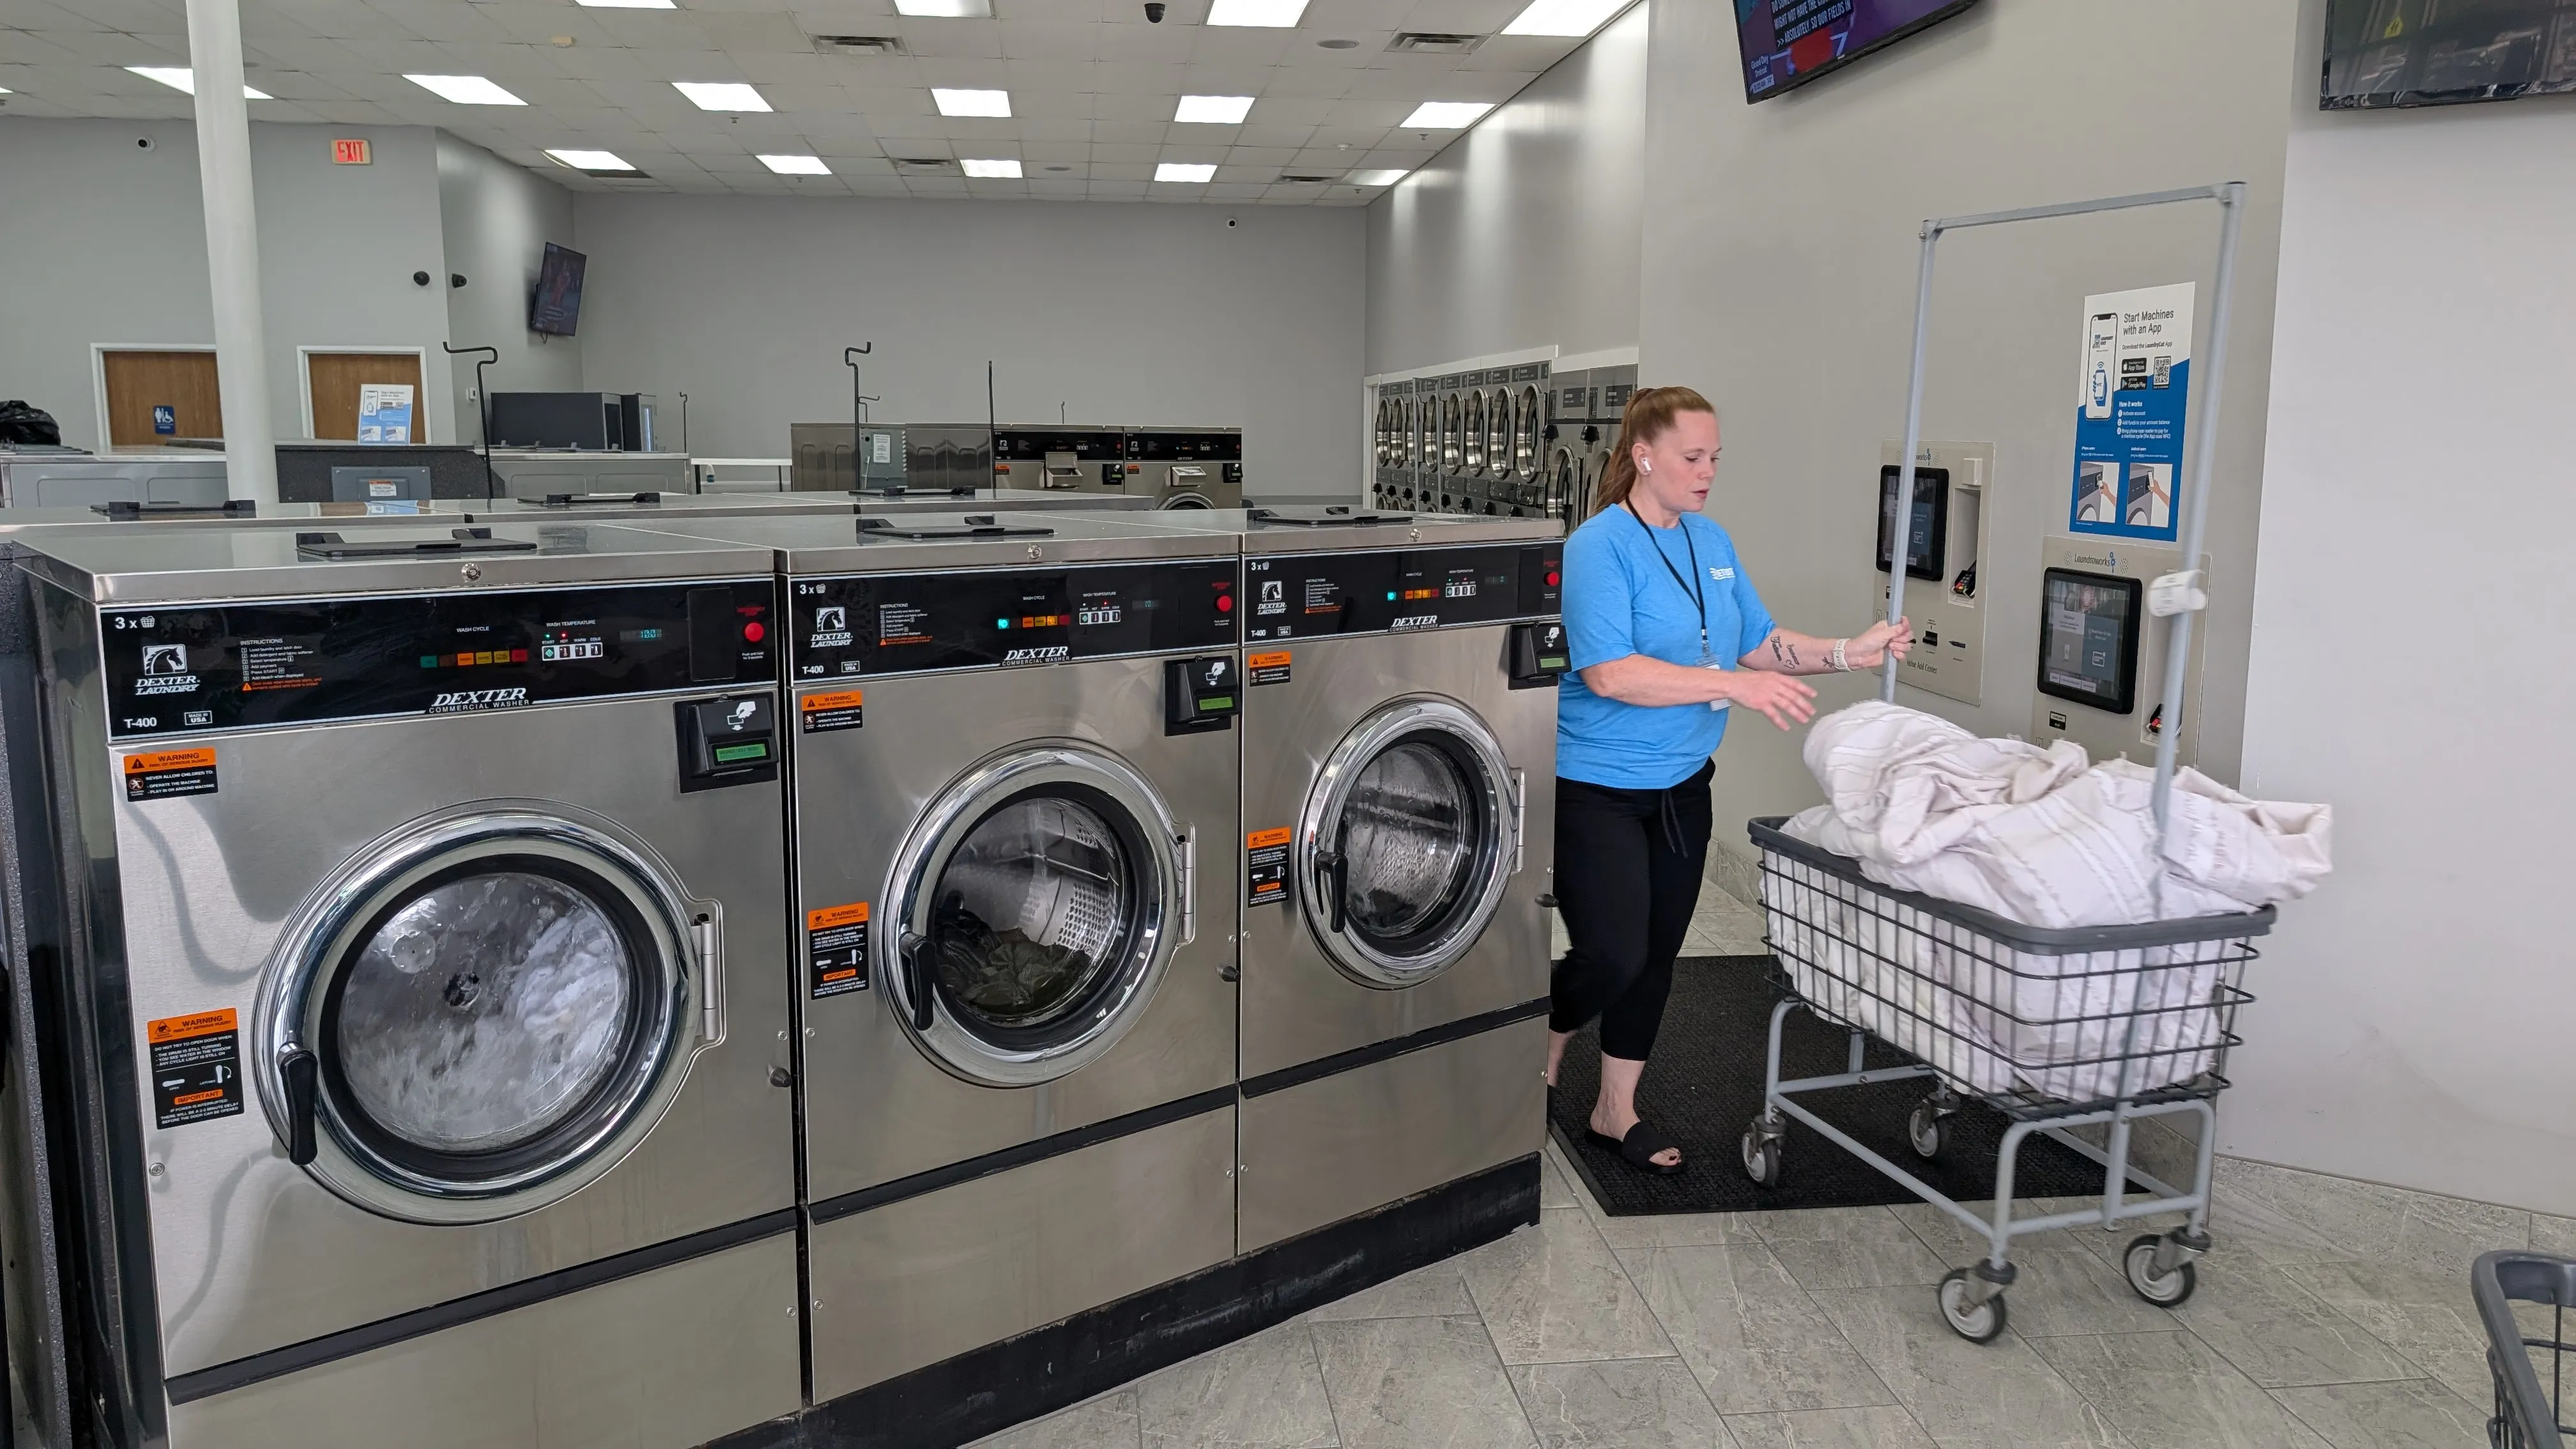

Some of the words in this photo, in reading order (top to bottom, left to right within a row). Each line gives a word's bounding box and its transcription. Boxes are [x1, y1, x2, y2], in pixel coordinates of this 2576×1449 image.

[1774, 13, 1788, 30] MIGHT
[1788, 8, 1796, 22] NOT
[1797, 2, 1808, 18] HAVE
[1808, 0, 1818, 12] THE
[1811, 16, 1818, 29] SO
[1818, 10, 1828, 26] OUR
[1828, 1, 1845, 20] FIELDS
[337, 141, 364, 162] EXIT
[2124, 312, 2140, 323] Start
[2142, 309, 2174, 321] Machines
[2123, 325, 2136, 335] with
[2138, 326, 2146, 334] an
[2148, 323, 2162, 335] App
[2074, 553, 2110, 567] Laundroworks
[1251, 562, 1256, 571] 3
[800, 584, 807, 594] 3
[1257, 602, 1285, 610] DEXTER
[115, 617, 126, 629] 3
[129, 620, 138, 629] x
[1392, 615, 1438, 628] DEXTER
[810, 632, 851, 641] DEXTER
[810, 639, 853, 648] LAUNDRY
[1003, 647, 1068, 661] DEXTER
[1002, 658, 1043, 666] COMMERCIAL
[1906, 659, 1917, 668] Value
[1925, 664, 1937, 673] Center
[802, 666, 824, 675] T-400
[135, 676, 197, 687] DEXTER
[135, 684, 199, 695] LAUNDRY
[431, 687, 526, 707] DEXTER
[429, 703, 489, 714] COMMERCIAL
[493, 699, 530, 708] WASHER
[124, 717, 157, 728] T-400
[158, 753, 199, 762] WARNING
[181, 1016, 223, 1027] WARNING
[178, 1091, 220, 1103] IMPORTANT
